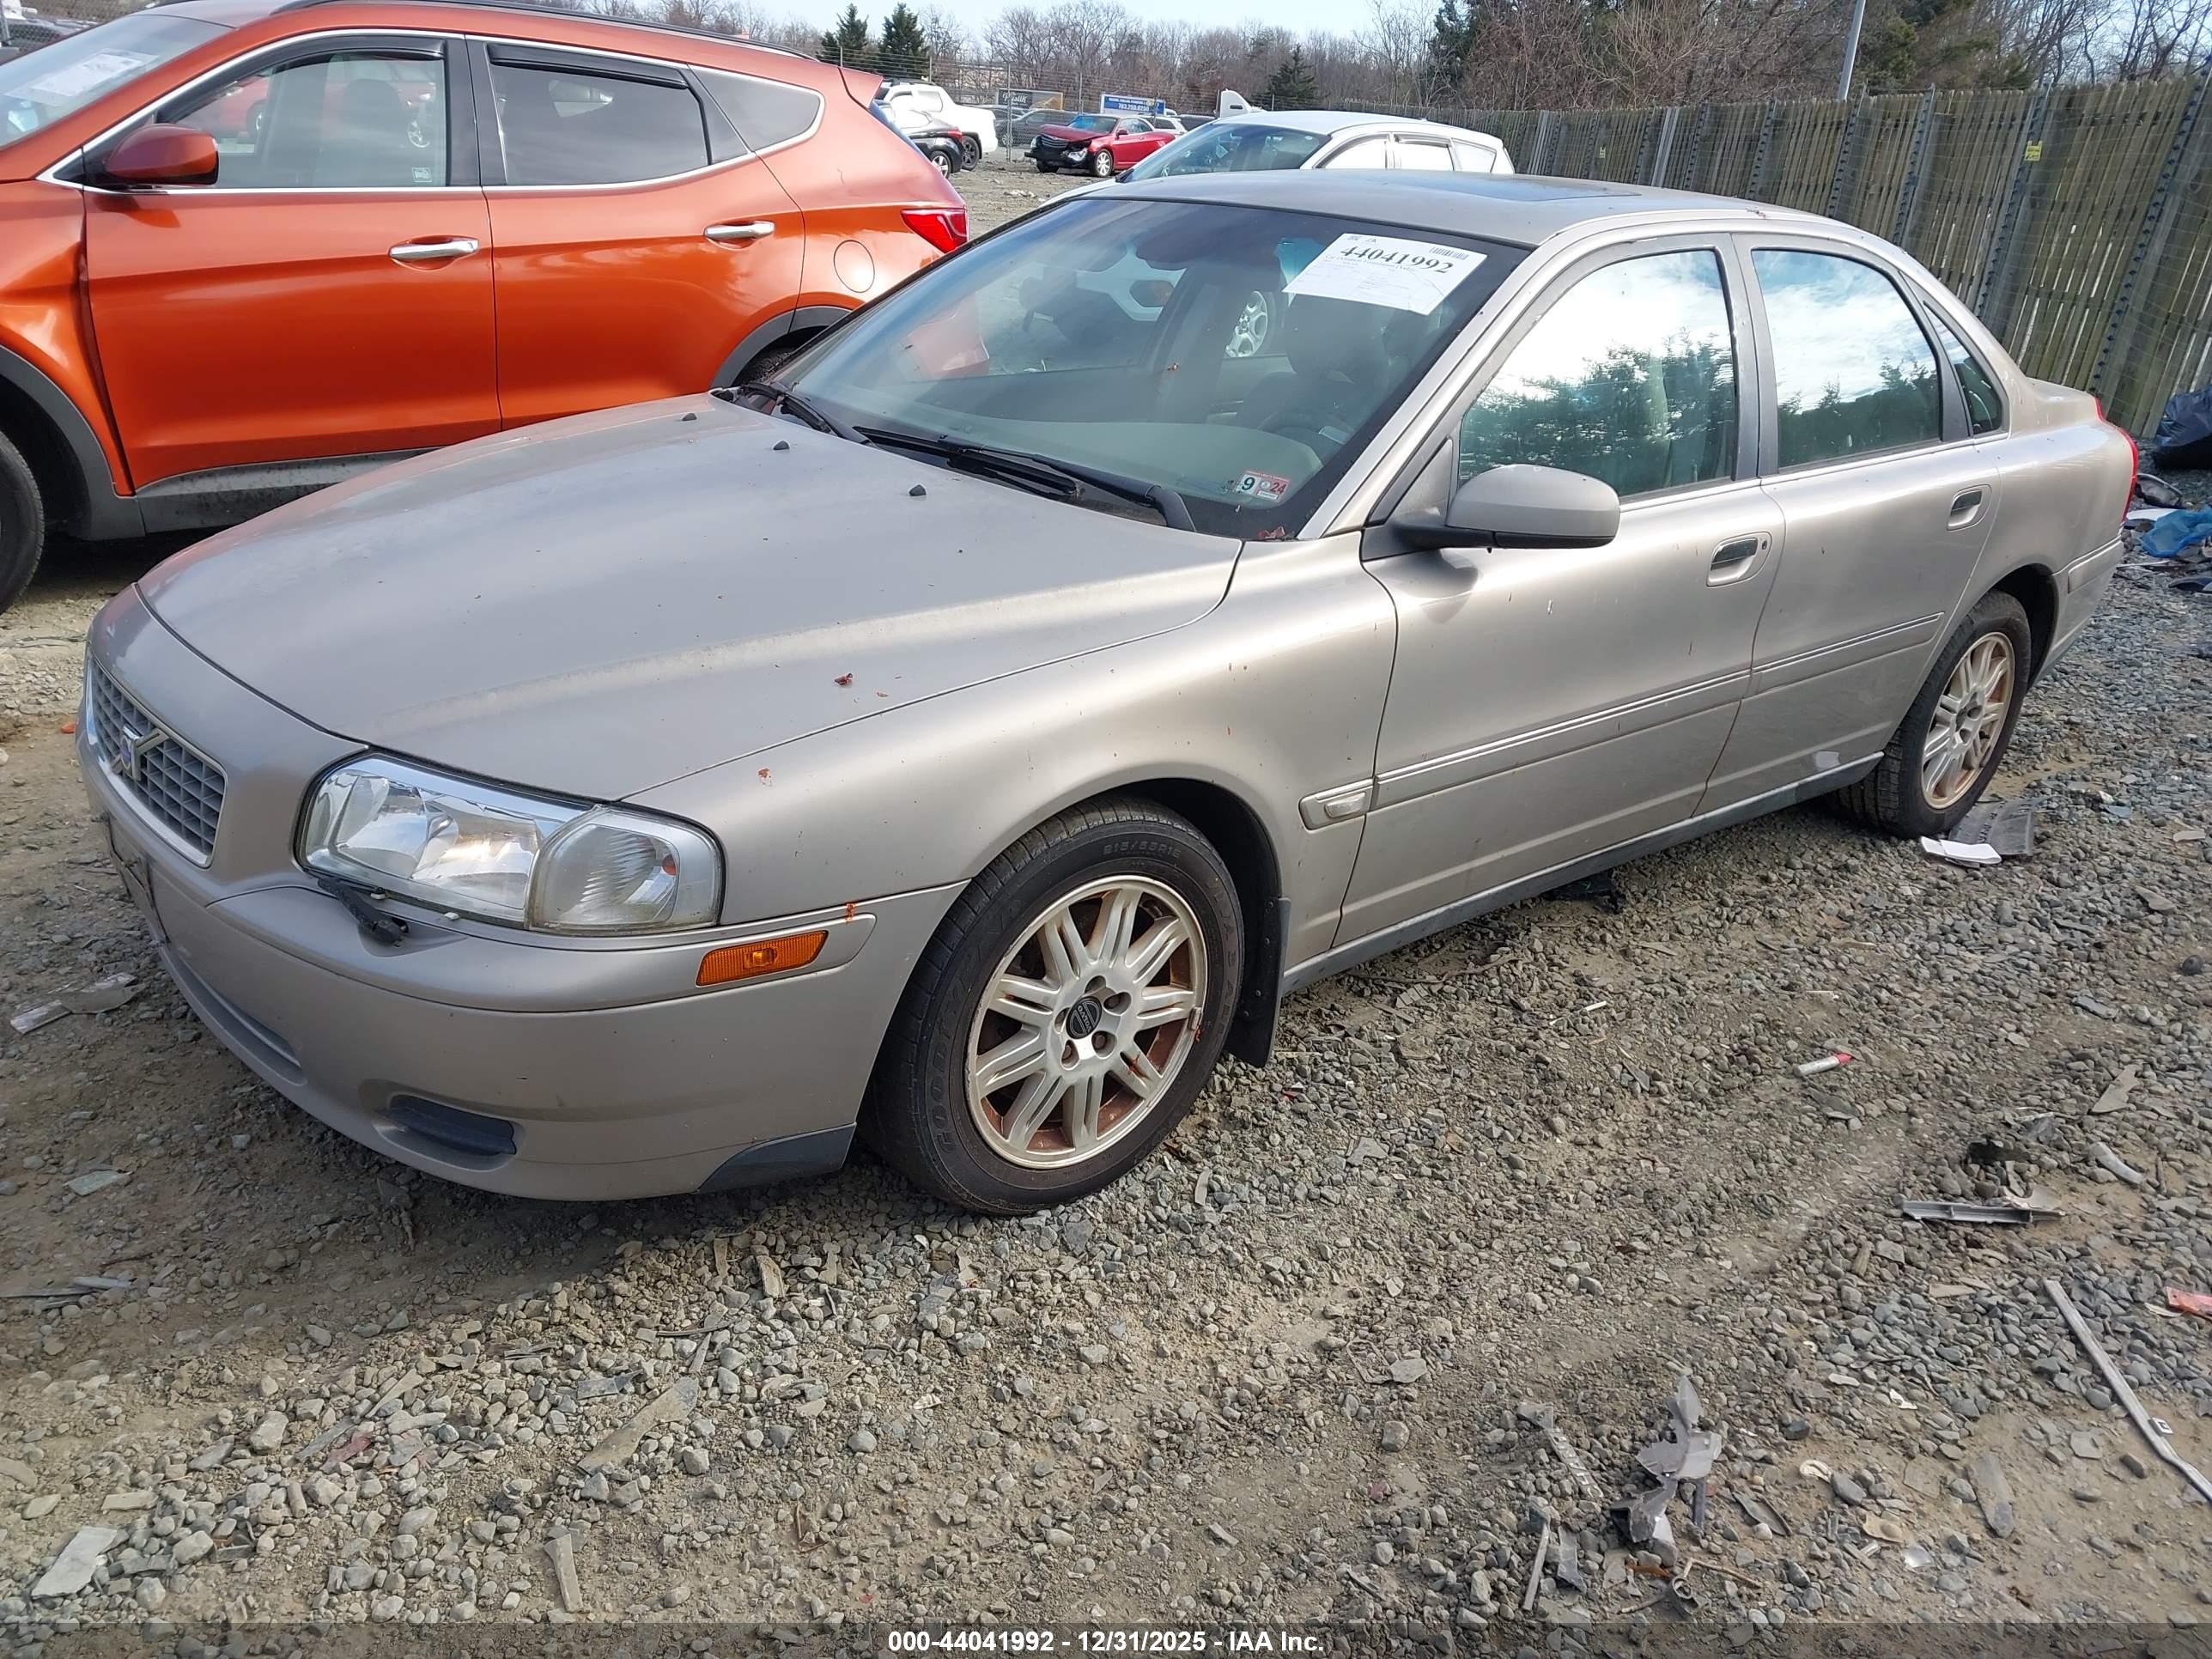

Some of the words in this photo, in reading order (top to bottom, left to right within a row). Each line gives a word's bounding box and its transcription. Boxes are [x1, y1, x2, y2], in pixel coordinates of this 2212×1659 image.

[1340, 246, 1454, 273] 44041992
[1242, 477, 1255, 490] 9
[1270, 482, 1286, 495] 24
[1078, 1005, 1092, 1034] VOLVO
